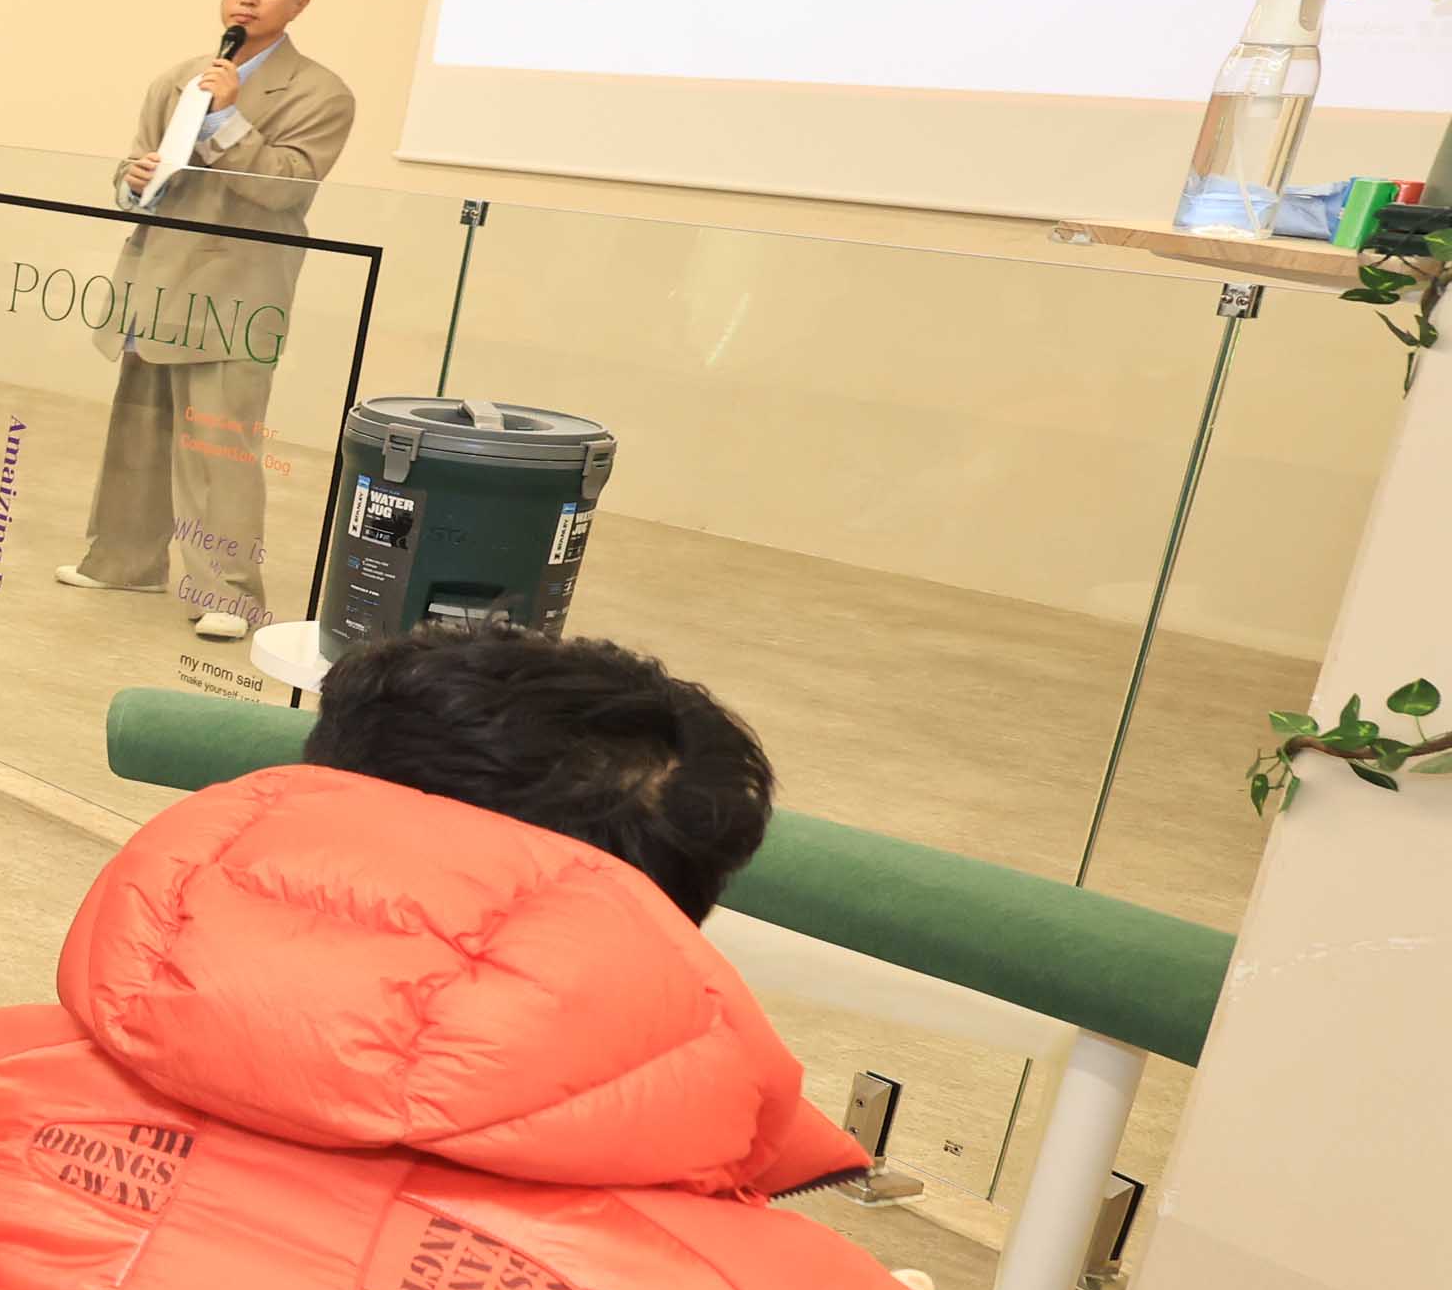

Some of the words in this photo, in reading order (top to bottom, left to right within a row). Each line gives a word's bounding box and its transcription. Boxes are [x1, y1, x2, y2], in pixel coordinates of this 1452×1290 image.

[6, 261, 286, 365] POOLLING
[367, 503, 393, 519] JUG
[370, 490, 415, 512] WATER
[173, 515, 239, 557] Where
[178, 573, 275, 626] Guardian
[179, 653, 199, 673] my
[201, 660, 234, 683] mom
[235, 669, 264, 693] said
